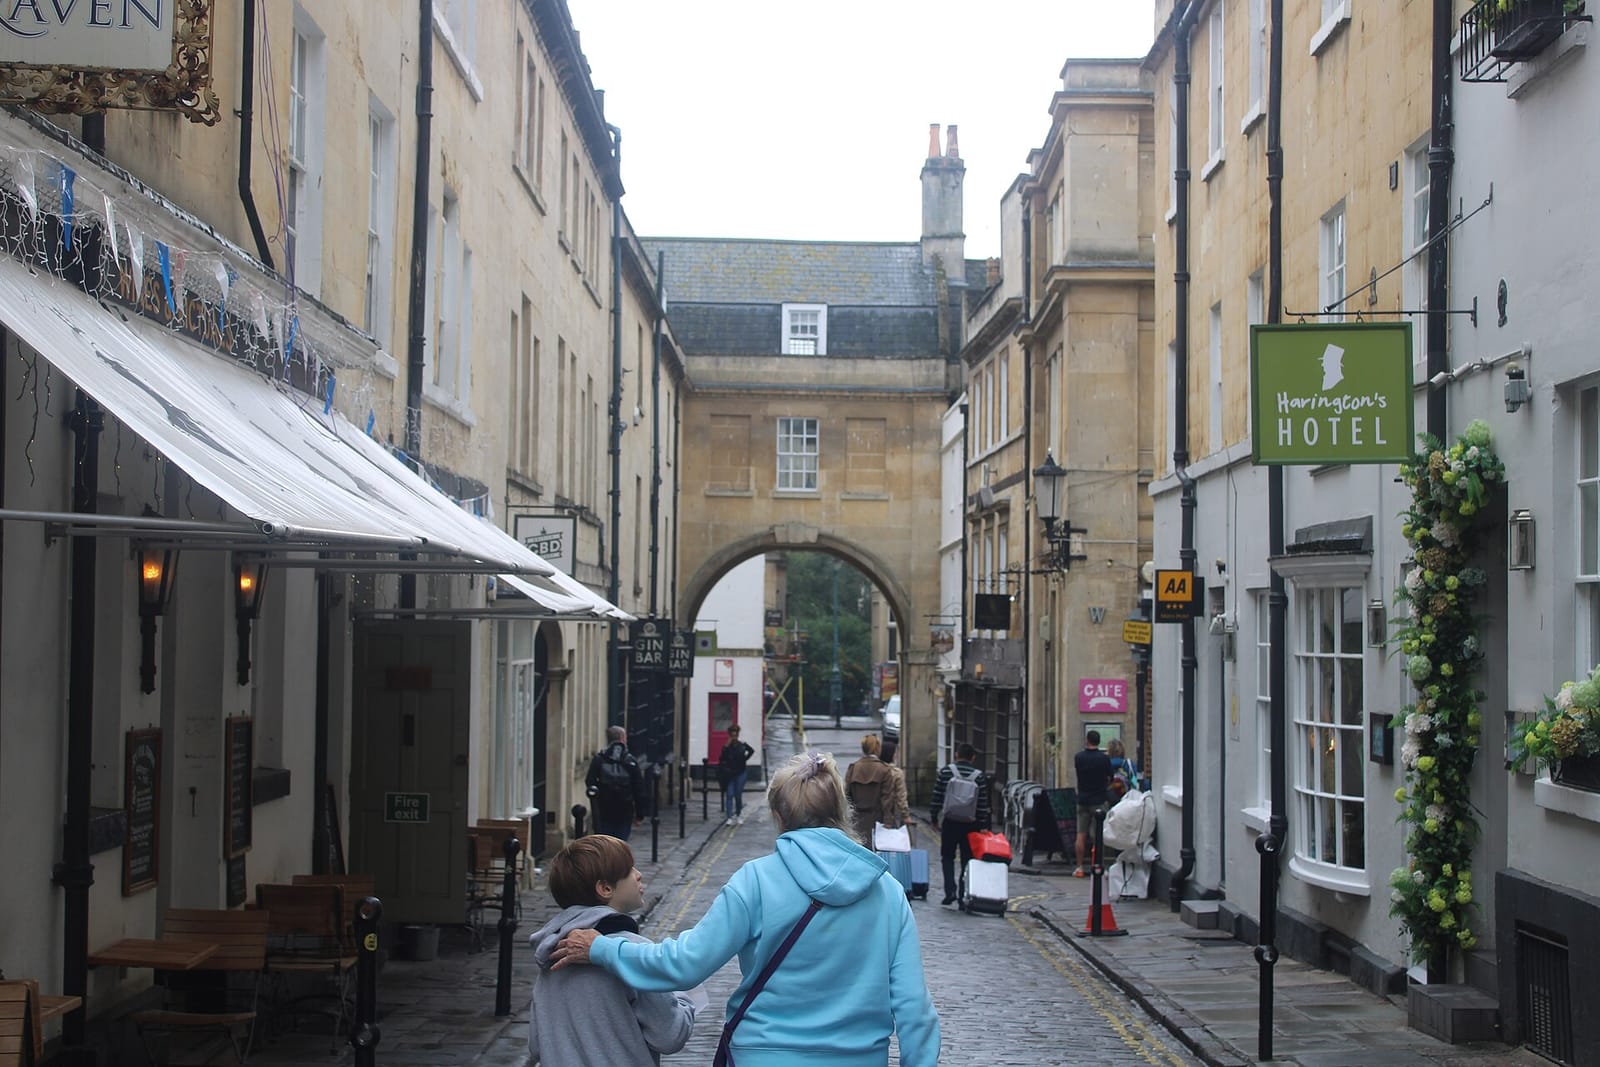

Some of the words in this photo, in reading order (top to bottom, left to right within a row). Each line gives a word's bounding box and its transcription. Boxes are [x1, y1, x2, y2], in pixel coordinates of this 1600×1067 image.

[0, 0, 162, 38] AVEN
[1276, 391, 1388, 415] Harington's
[1278, 416, 1388, 447] HOTEL
[528, 539, 561, 555] CBD
[1164, 577, 1187, 595] AA
[1087, 606, 1107, 625] W
[634, 639, 664, 651] GIN
[634, 651, 663, 664] BAR
[1083, 683, 1123, 697] CAFE
[393, 795, 420, 808] Fire
[393, 808, 420, 820] exit
